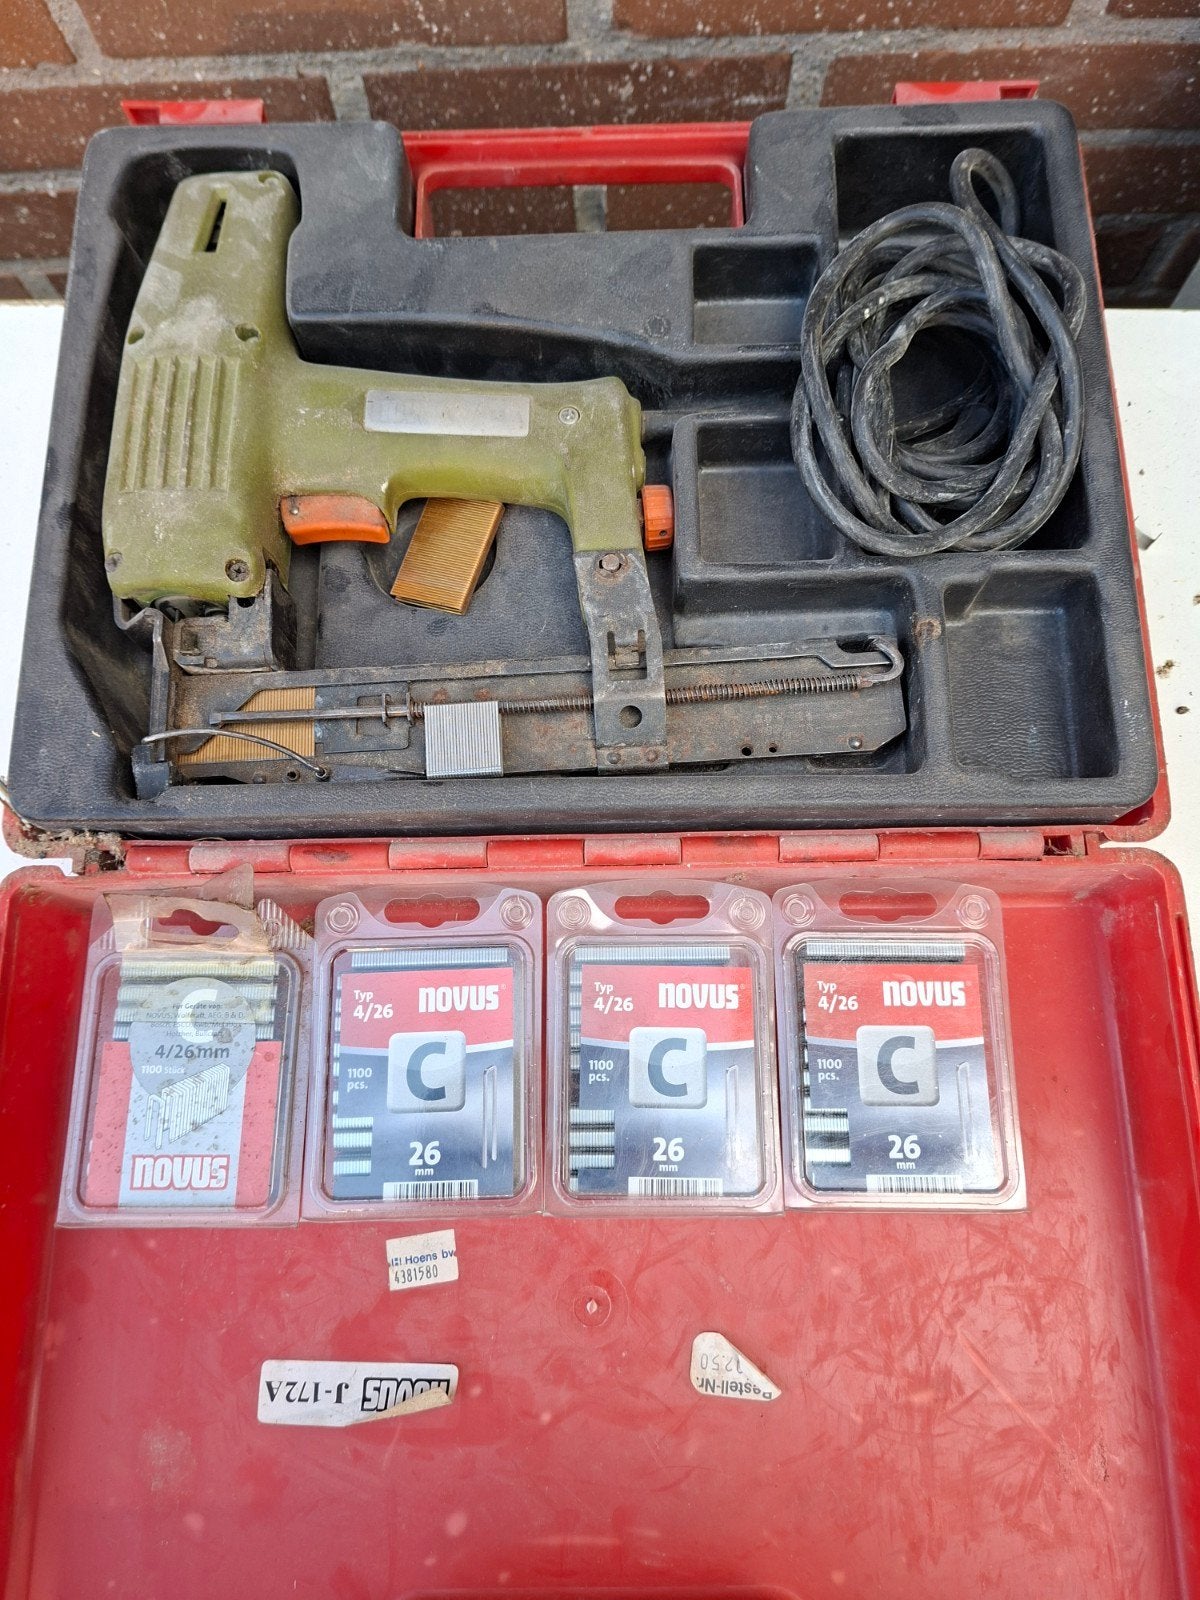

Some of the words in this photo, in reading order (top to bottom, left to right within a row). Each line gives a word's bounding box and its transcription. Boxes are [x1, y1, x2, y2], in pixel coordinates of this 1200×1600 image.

[593, 981, 614, 996] Typ
[816, 980, 837, 994] Typ
[353, 989, 374, 1004] Typ
[593, 997, 634, 1015] 4/26
[817, 995, 859, 1014] 4/26
[352, 1003, 394, 1023] 4/26
[140, 1064, 163, 1075] 1100
[406, 1041, 447, 1102] C
[588, 1059, 614, 1071] 1100
[647, 1037, 689, 1098] C
[816, 1058, 843, 1070] 1100
[877, 1035, 920, 1096] C
[347, 1067, 373, 1079] 1100
[588, 1072, 611, 1085] pcs.
[817, 1071, 840, 1084] pcs.
[346, 1080, 369, 1093] pcs.
[408, 1140, 441, 1166] 26
[652, 1137, 685, 1163] 26
[887, 1134, 921, 1160] 26
[414, 1166, 434, 1176] mm
[658, 1162, 679, 1172] mm
[896, 1160, 916, 1170] mm
[404, 1252, 438, 1265] Hoens
[394, 1264, 439, 1284] 4381580
[265, 1380, 350, 1404] J-172A
